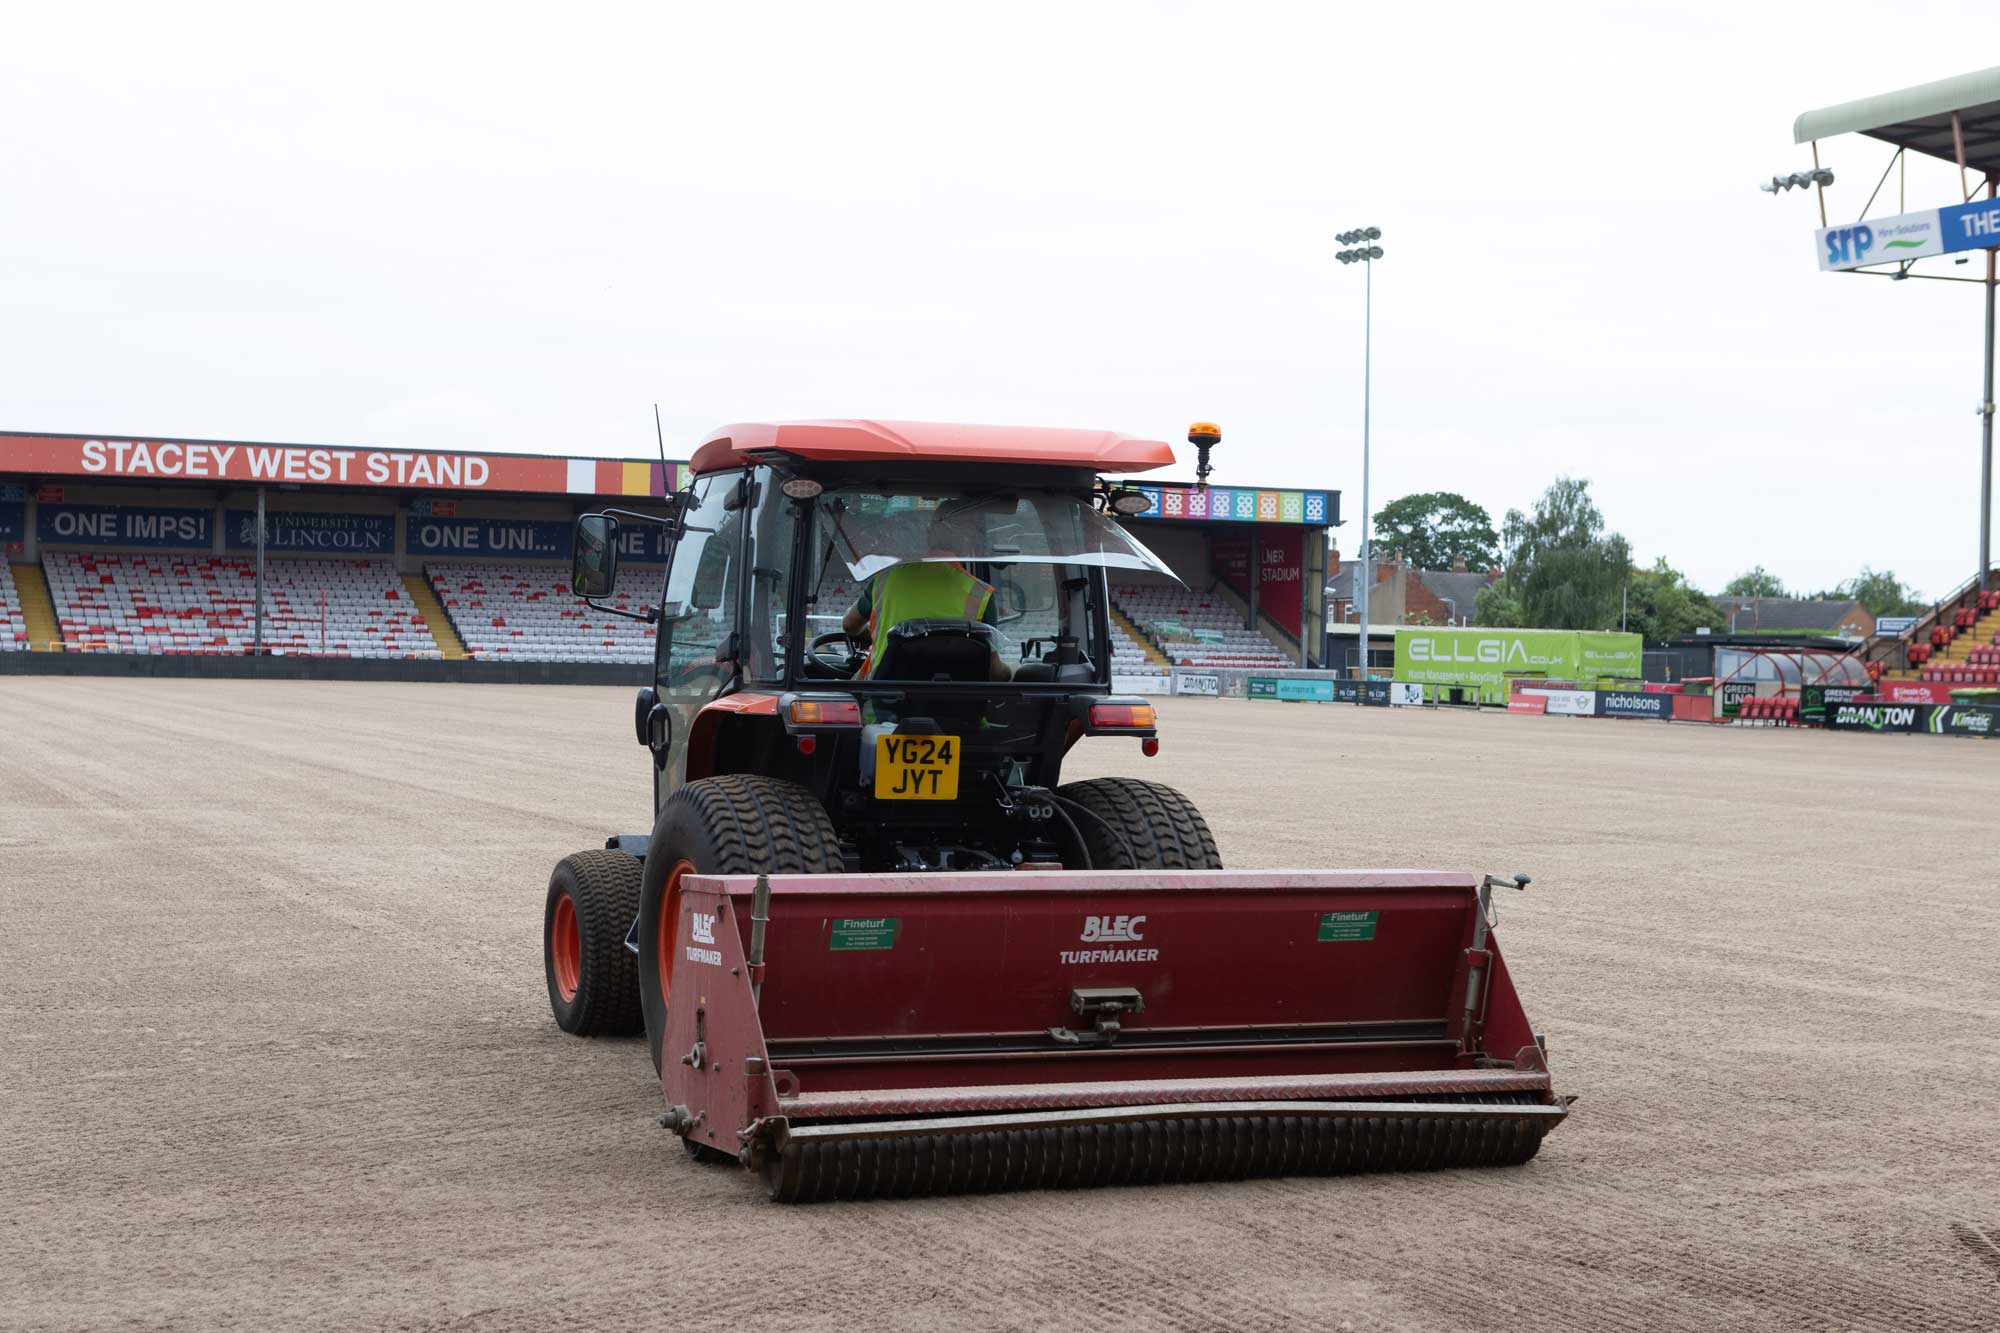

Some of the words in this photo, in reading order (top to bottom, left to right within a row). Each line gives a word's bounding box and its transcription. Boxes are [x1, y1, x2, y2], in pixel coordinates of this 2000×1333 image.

[81, 440, 236, 477] STACEY
[246, 447, 356, 481] WEST
[366, 452, 489, 487] STAND
[54, 511, 118, 537] ONE
[126, 514, 206, 541] IMPS!
[274, 516, 361, 529] UNIVERSITY
[364, 518, 382, 530] OF
[274, 528, 382, 548] LINCOLN
[421, 525, 480, 548] ONE
[488, 527, 557, 551] UNI...
[1262, 567, 1300, 581] STADIUM
[1723, 684, 1754, 693] GREEN
[1605, 693, 1661, 711] nicholsons
[1836, 706, 1915, 728] BRANSTON
[884, 737, 953, 765] YG24
[891, 769, 944, 795] JYT
[842, 918, 886, 929] Fineturf
[1330, 911, 1369, 921] Fineturf
[692, 912, 715, 945] BLEC
[1080, 915, 1147, 942] BLEC
[685, 946, 722, 966] TURFMAKER
[1059, 948, 1159, 964] TURFMAKER
